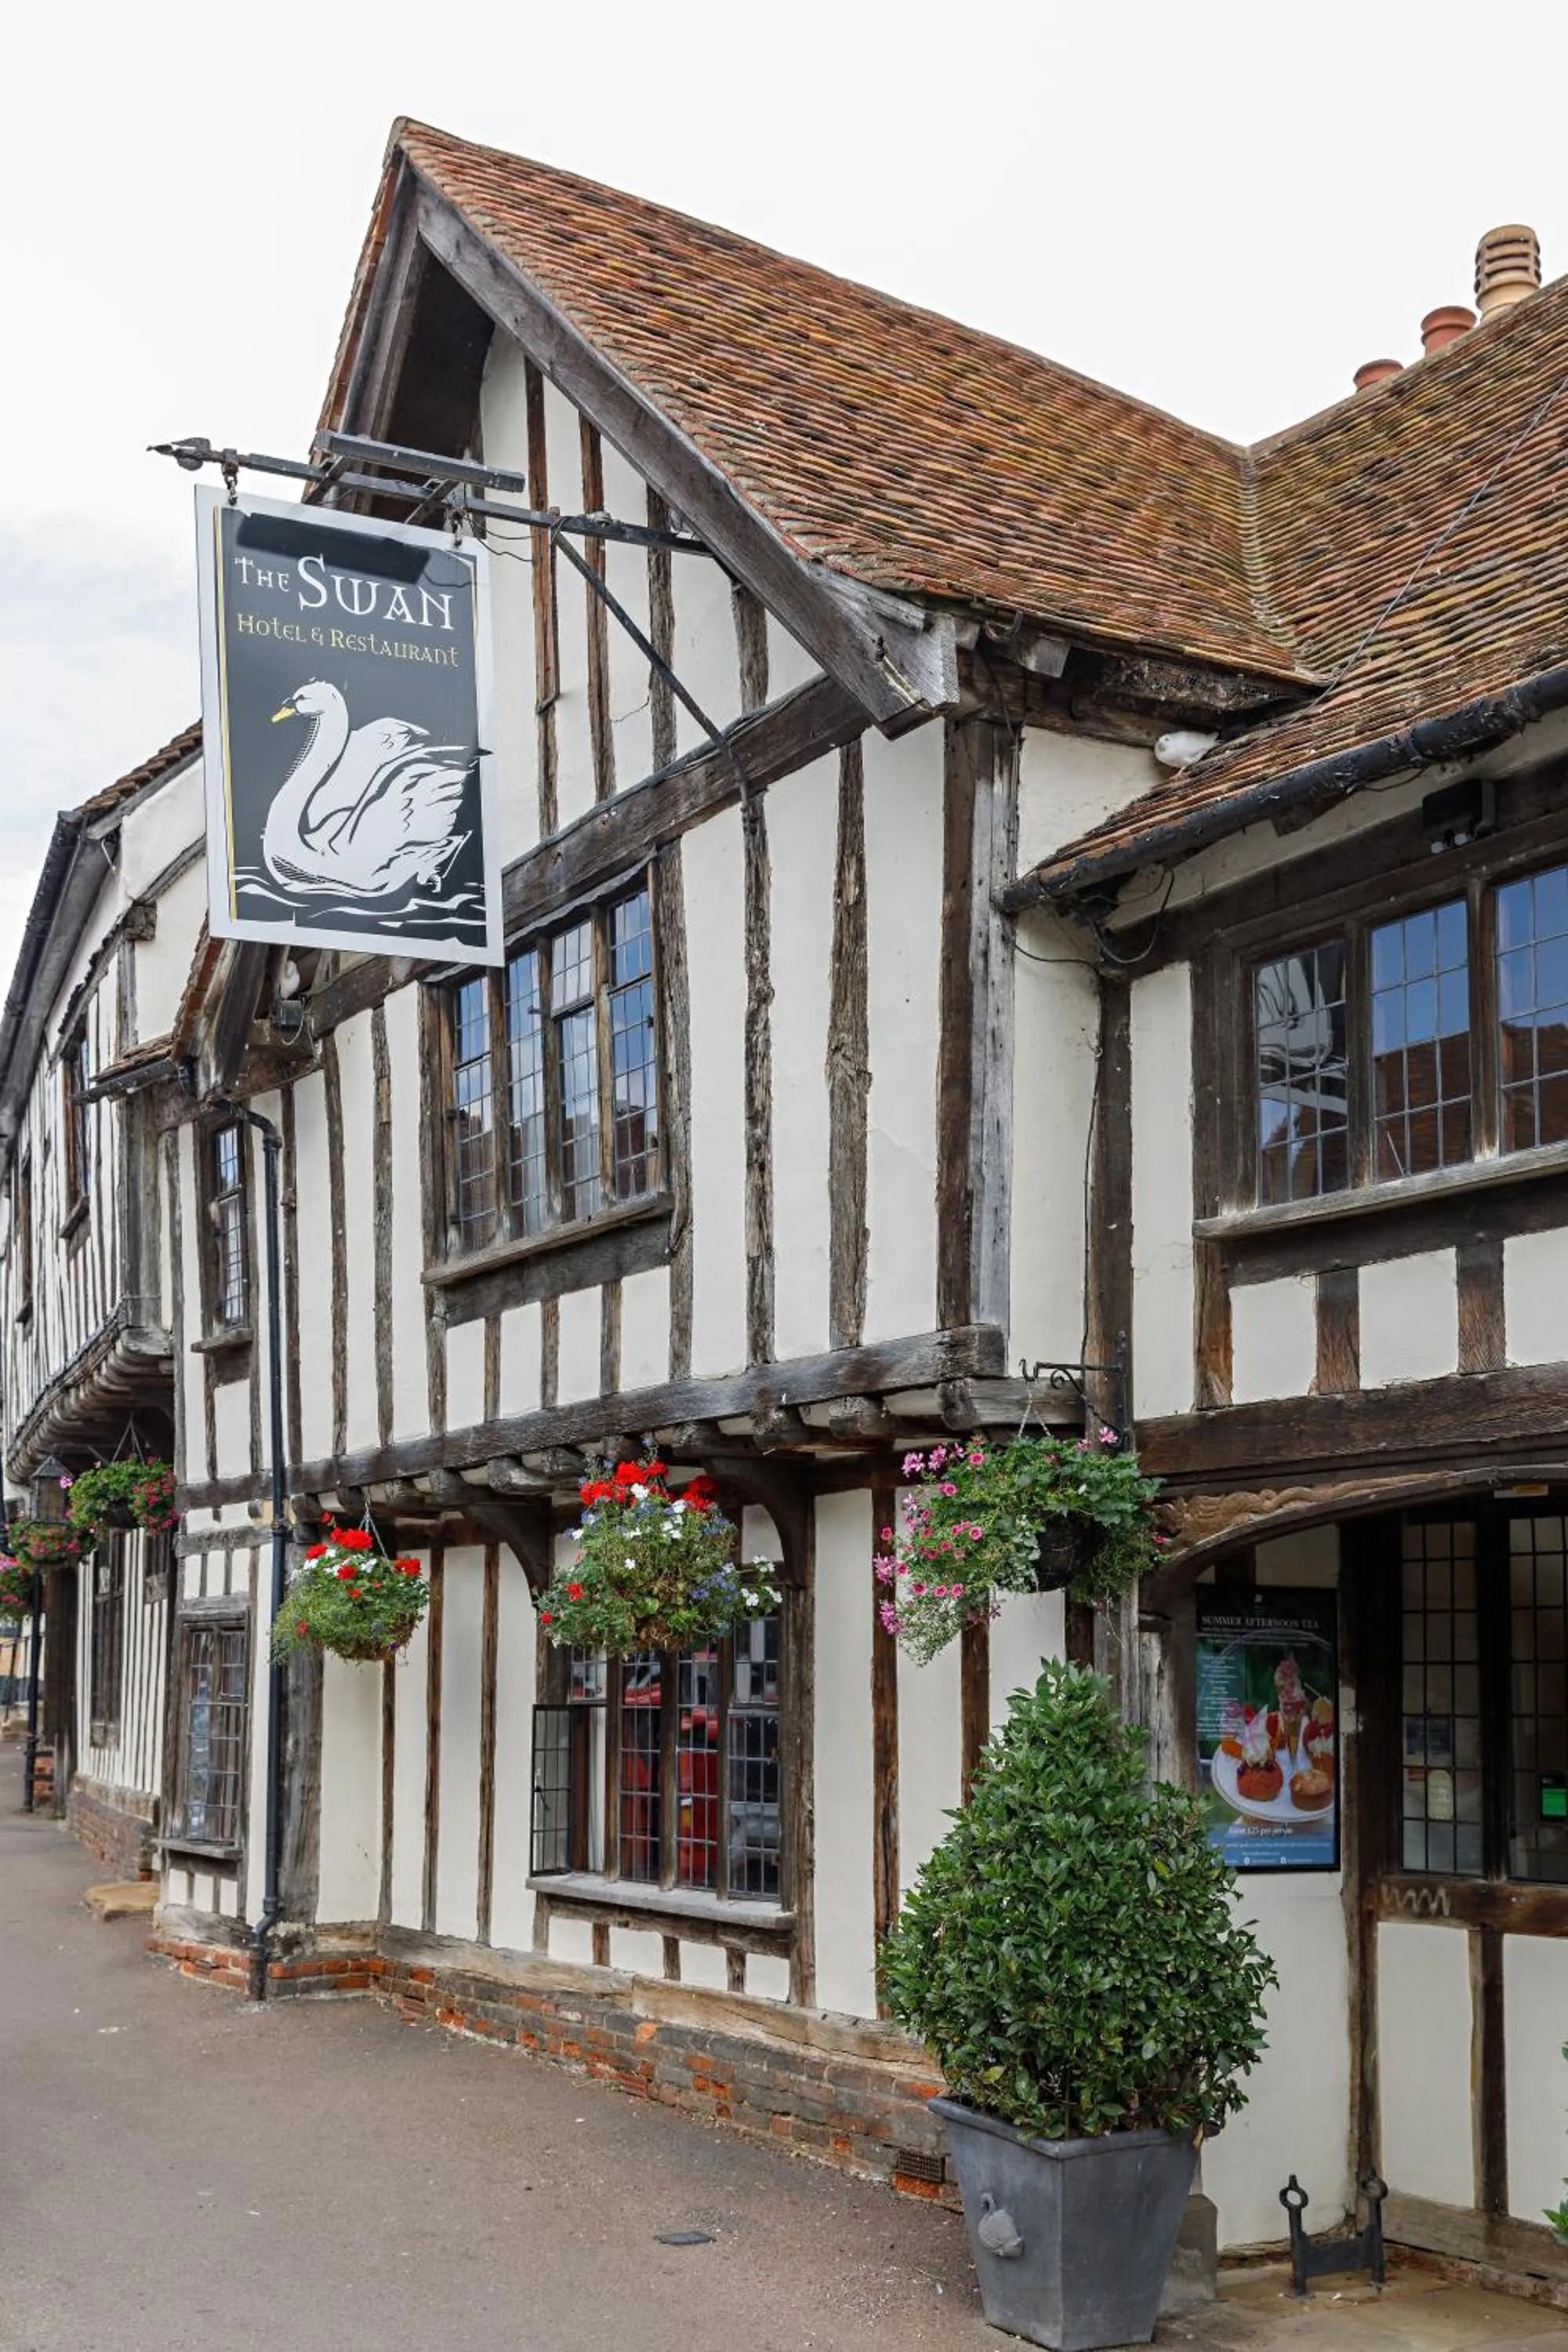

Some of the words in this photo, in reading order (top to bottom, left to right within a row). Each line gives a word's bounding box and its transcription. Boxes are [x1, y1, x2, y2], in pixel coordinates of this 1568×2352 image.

[234, 556, 289, 592] THE
[297, 554, 454, 630] SWAN
[237, 612, 307, 643] HOTEL
[311, 628, 324, 646] &
[330, 629, 459, 667] RESTAURANT
[1202, 1615, 1242, 1625] SUMMER
[1245, 1617, 1300, 1628] AFTERNOON
[1301, 1619, 1319, 1629] TEA
